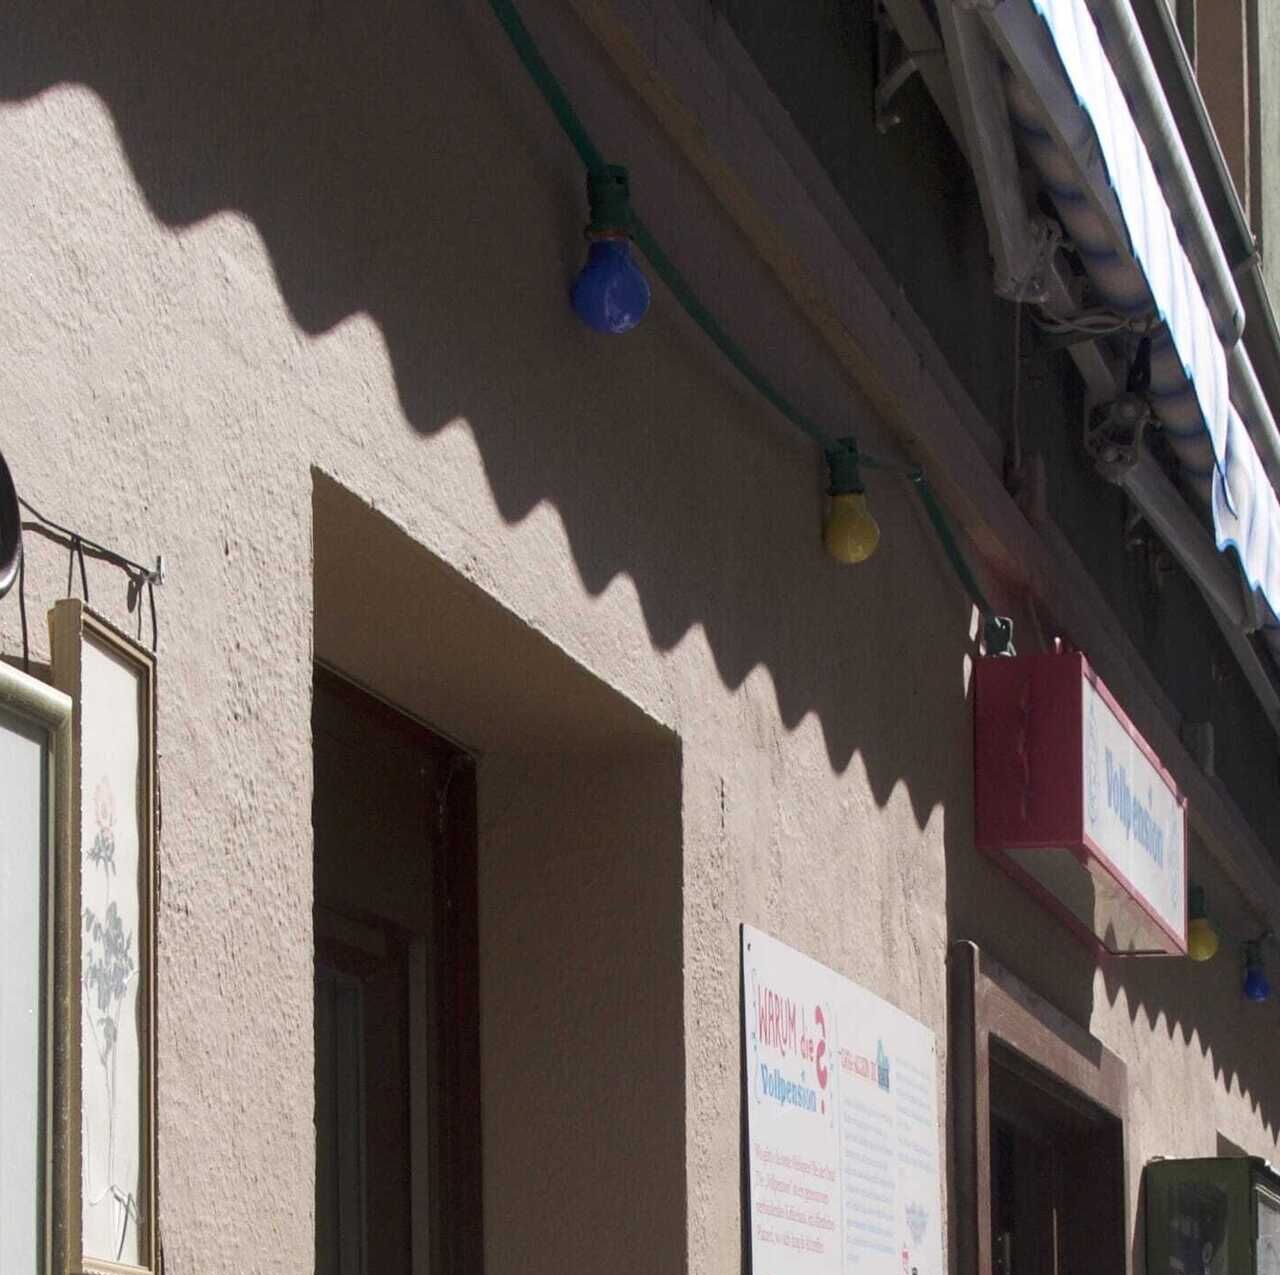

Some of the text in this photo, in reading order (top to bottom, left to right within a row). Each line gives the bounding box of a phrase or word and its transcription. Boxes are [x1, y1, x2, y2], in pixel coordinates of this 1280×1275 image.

[1104, 746, 1164, 868] Vollpension
[758, 984, 797, 1057] WARUM
[761, 1063, 817, 1113] Vollpension
